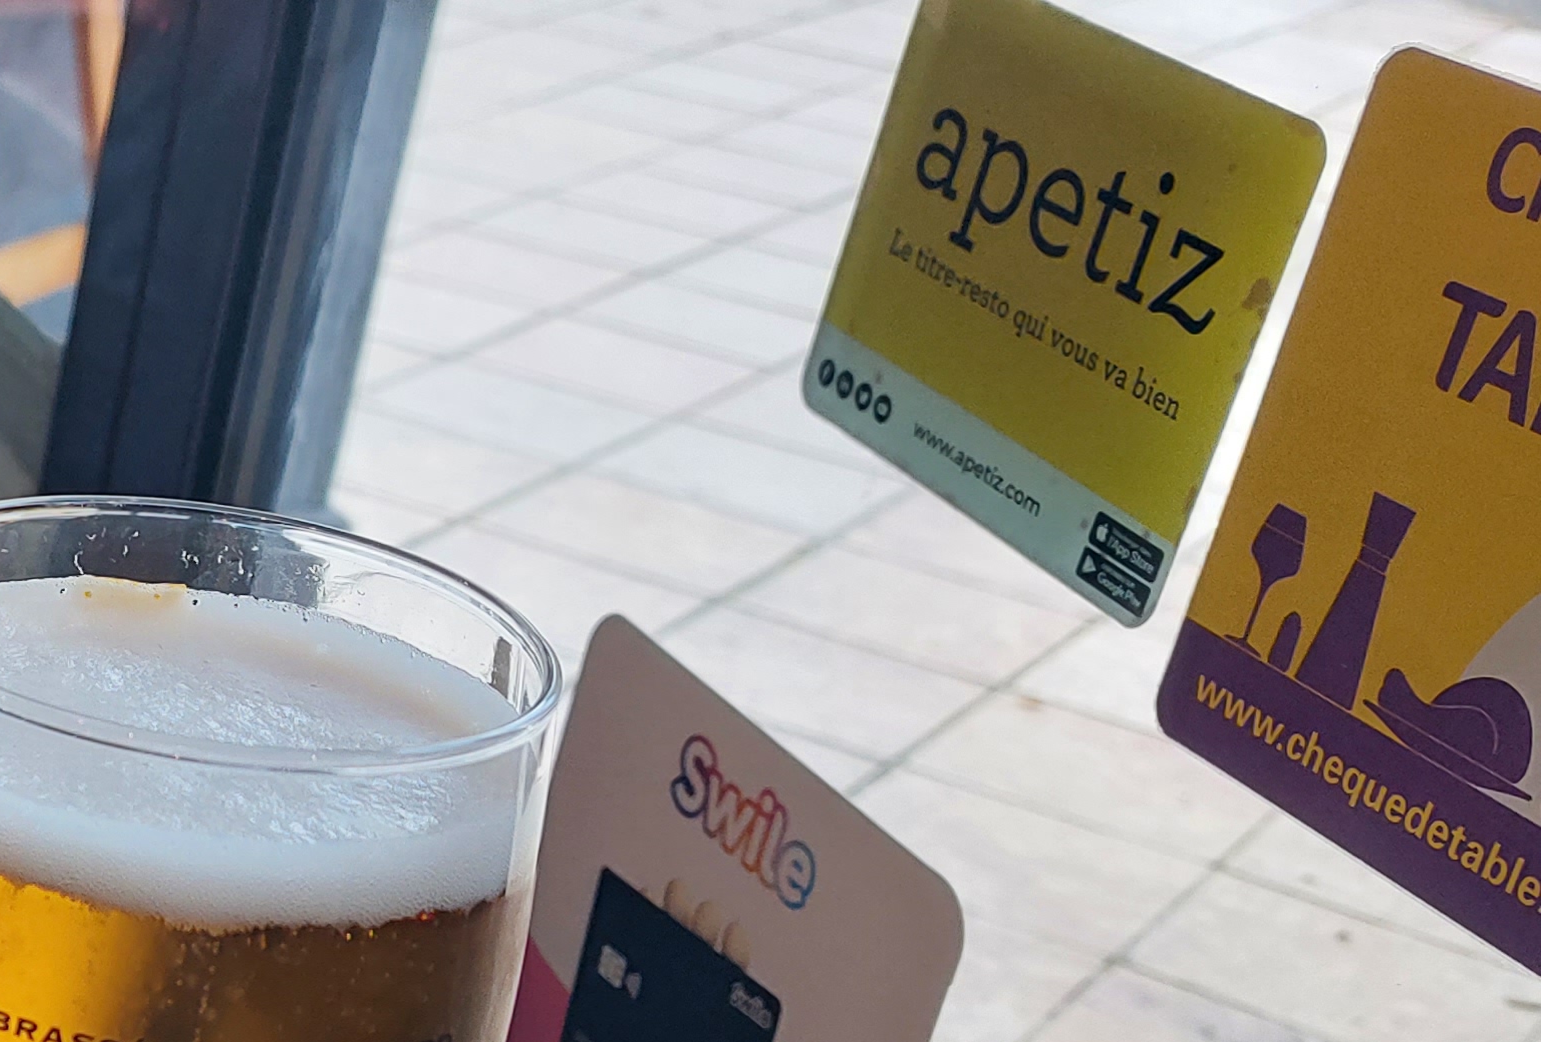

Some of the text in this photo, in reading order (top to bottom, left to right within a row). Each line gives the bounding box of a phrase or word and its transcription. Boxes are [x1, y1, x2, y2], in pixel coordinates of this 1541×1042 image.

[916, 107, 1226, 335] apetiz
[1486, 126, 1541, 222] C
[888, 227, 1181, 421] Le titre-resto qui vous va bien
[1435, 280, 1541, 436] TA
[913, 422, 1041, 517] www.apetiz.com
[669, 734, 816, 911] Swile
